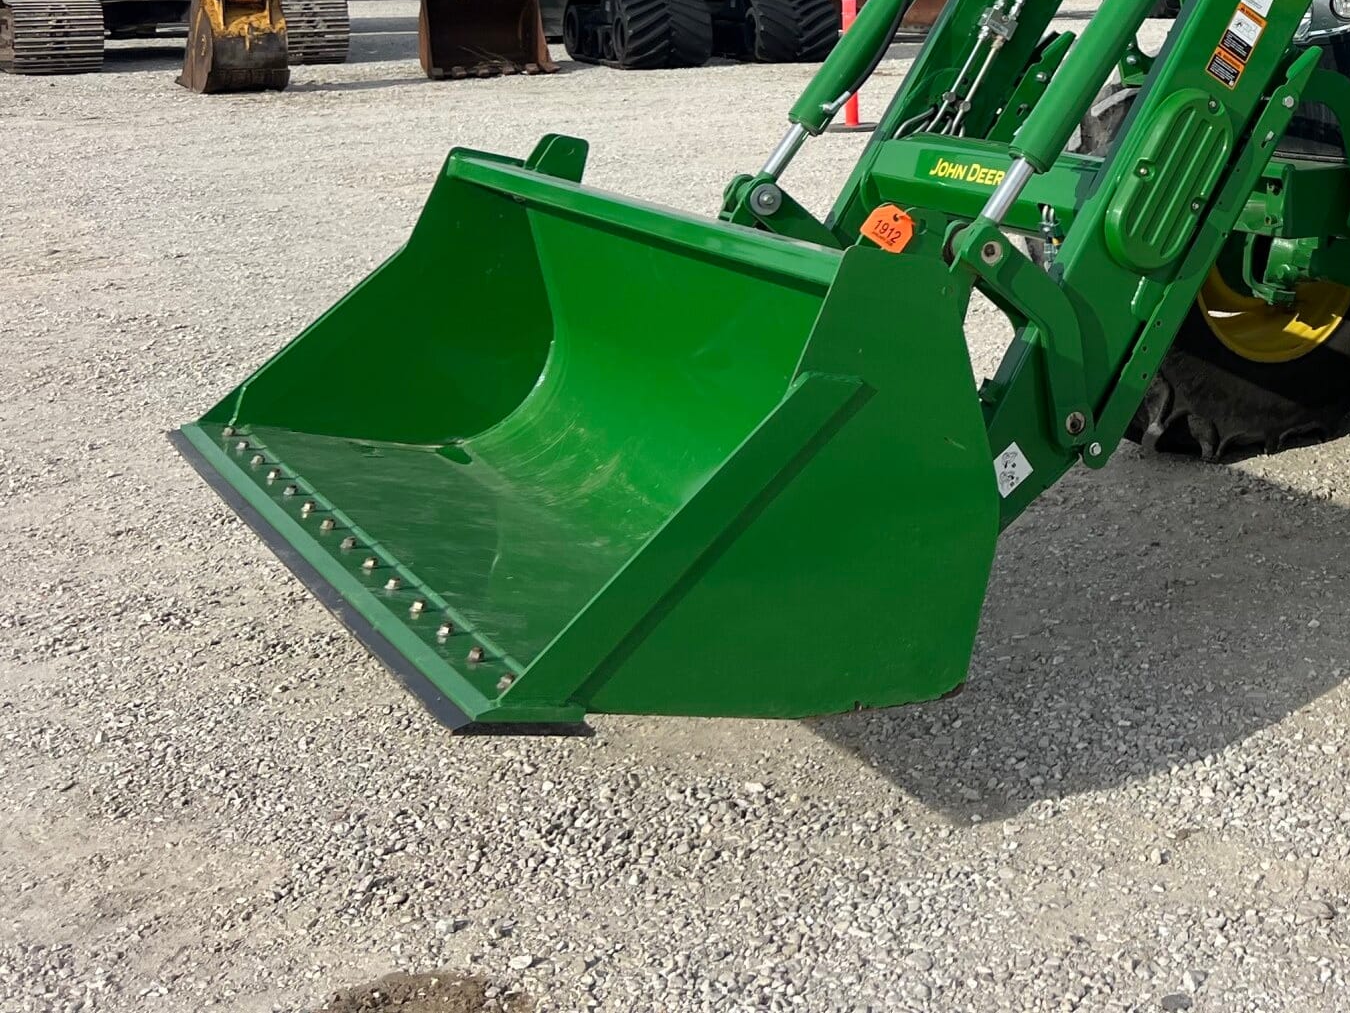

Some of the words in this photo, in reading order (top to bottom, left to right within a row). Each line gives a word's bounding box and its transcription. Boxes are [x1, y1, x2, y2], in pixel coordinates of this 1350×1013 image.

[929, 157, 968, 180] JOHN
[966, 163, 1006, 186] DEER
[873, 219, 902, 244] 1912
